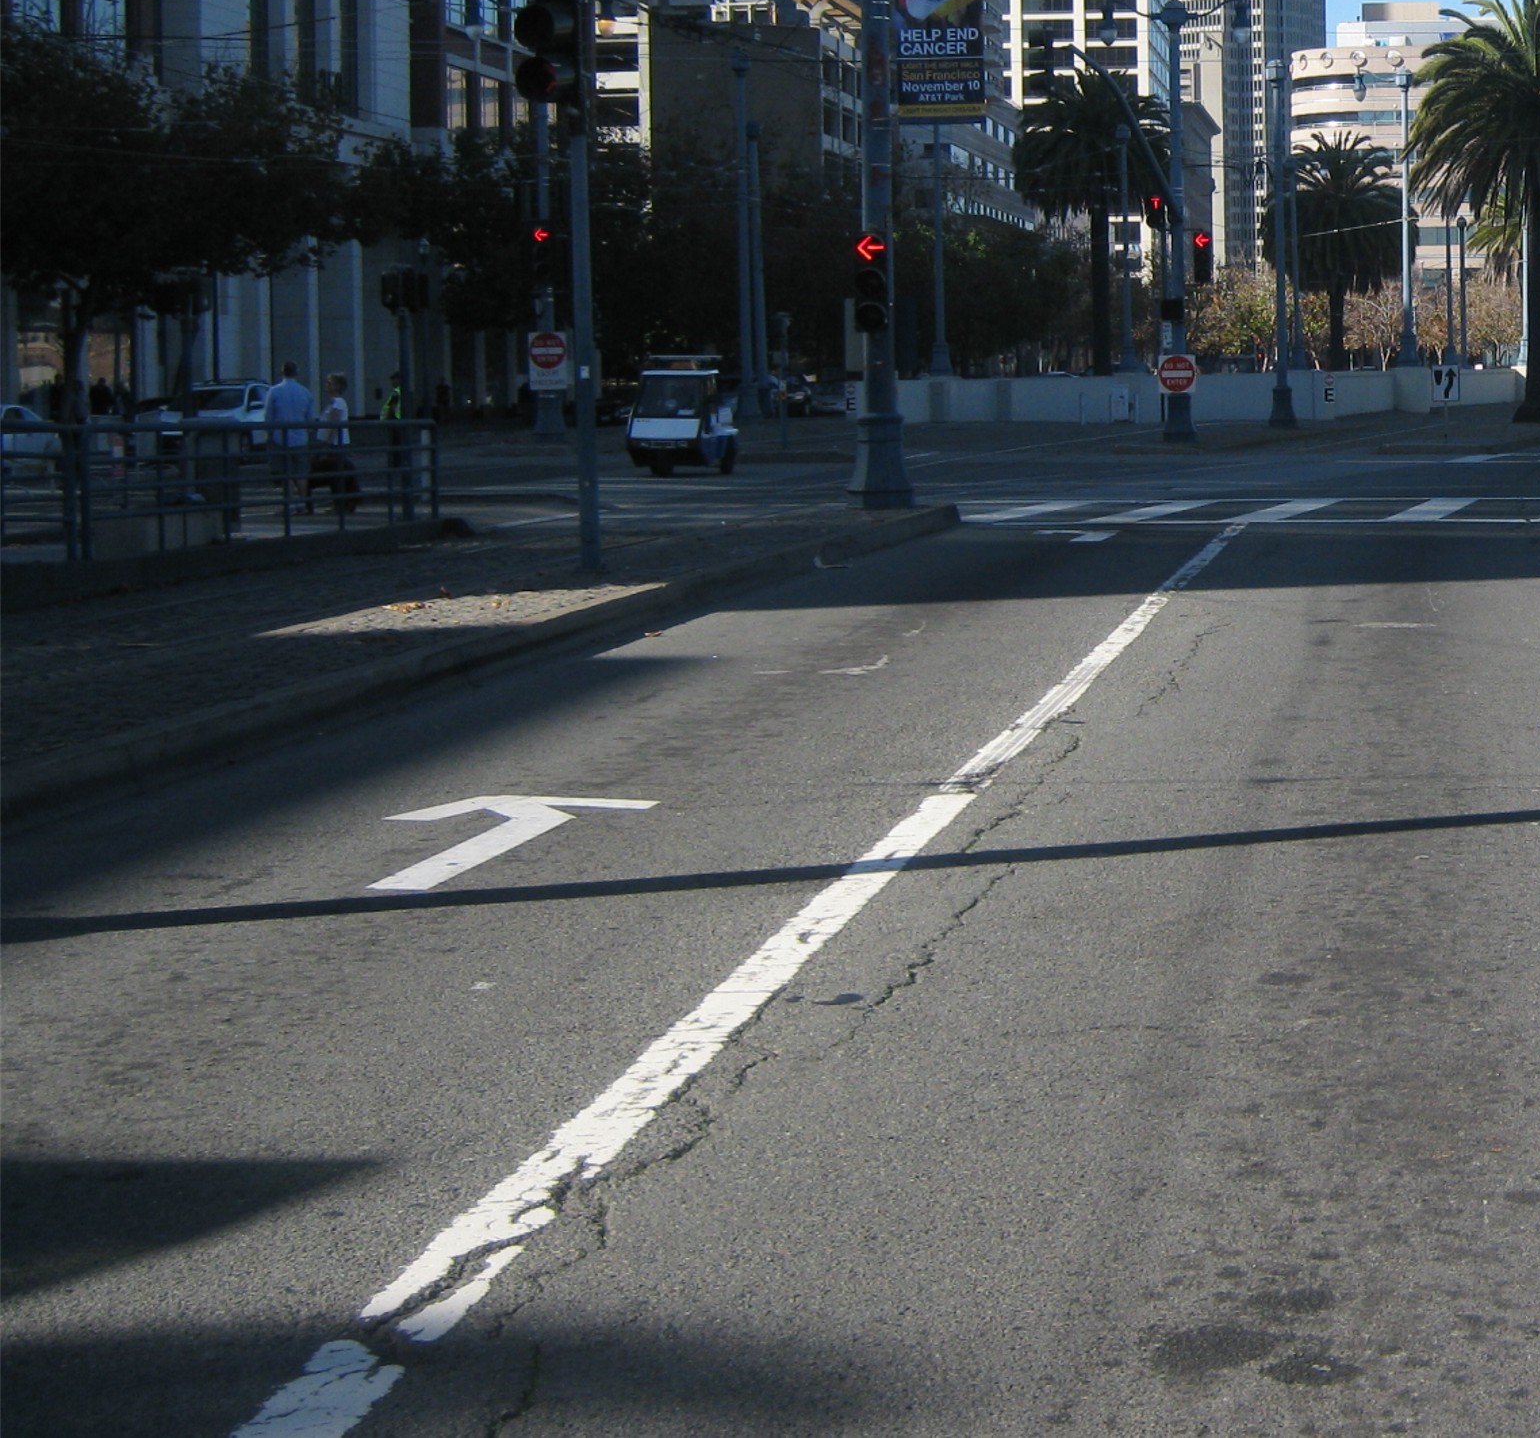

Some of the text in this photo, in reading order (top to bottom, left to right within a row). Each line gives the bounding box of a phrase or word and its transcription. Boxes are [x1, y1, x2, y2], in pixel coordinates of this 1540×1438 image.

[900, 27, 979, 42] HELP END
[900, 42, 967, 55] CANCER
[902, 70, 980, 81] San Francisco
[902, 80, 980, 93] November 10
[918, 92, 965, 102] AT&T Park
[536, 355, 559, 363] ENTER
[1164, 362, 1191, 370] DO NOT
[1167, 378, 1189, 386] ENTER
[1324, 387, 1335, 403] E
